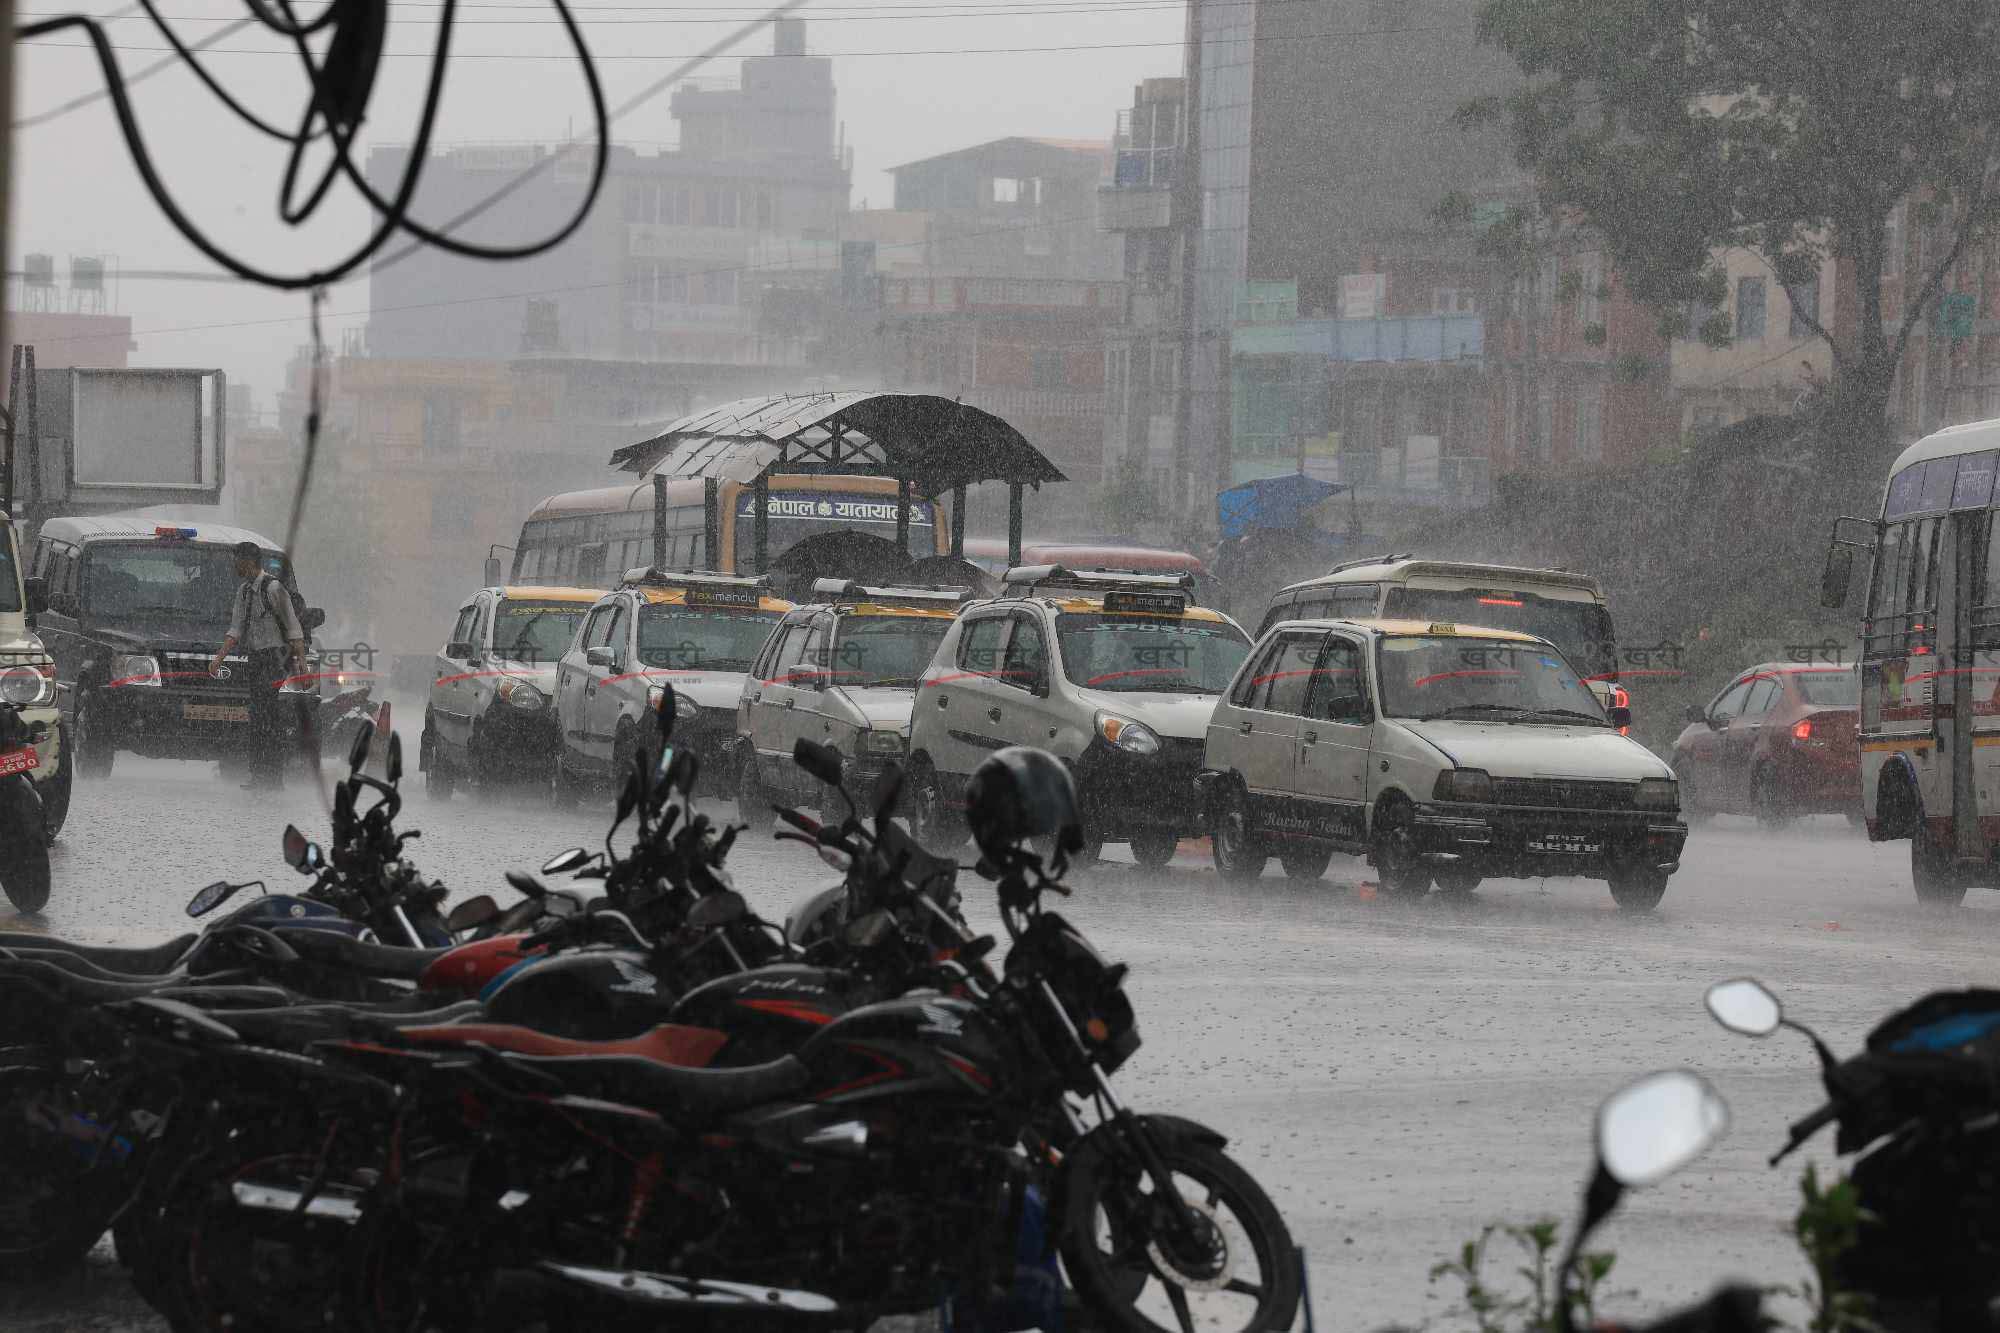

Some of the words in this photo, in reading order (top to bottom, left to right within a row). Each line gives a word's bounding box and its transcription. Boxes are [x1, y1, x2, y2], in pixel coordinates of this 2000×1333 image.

[768, 495, 815, 516] नेपाल
[692, 591, 756, 603] taximandu
[1263, 811, 1311, 832] Racing
